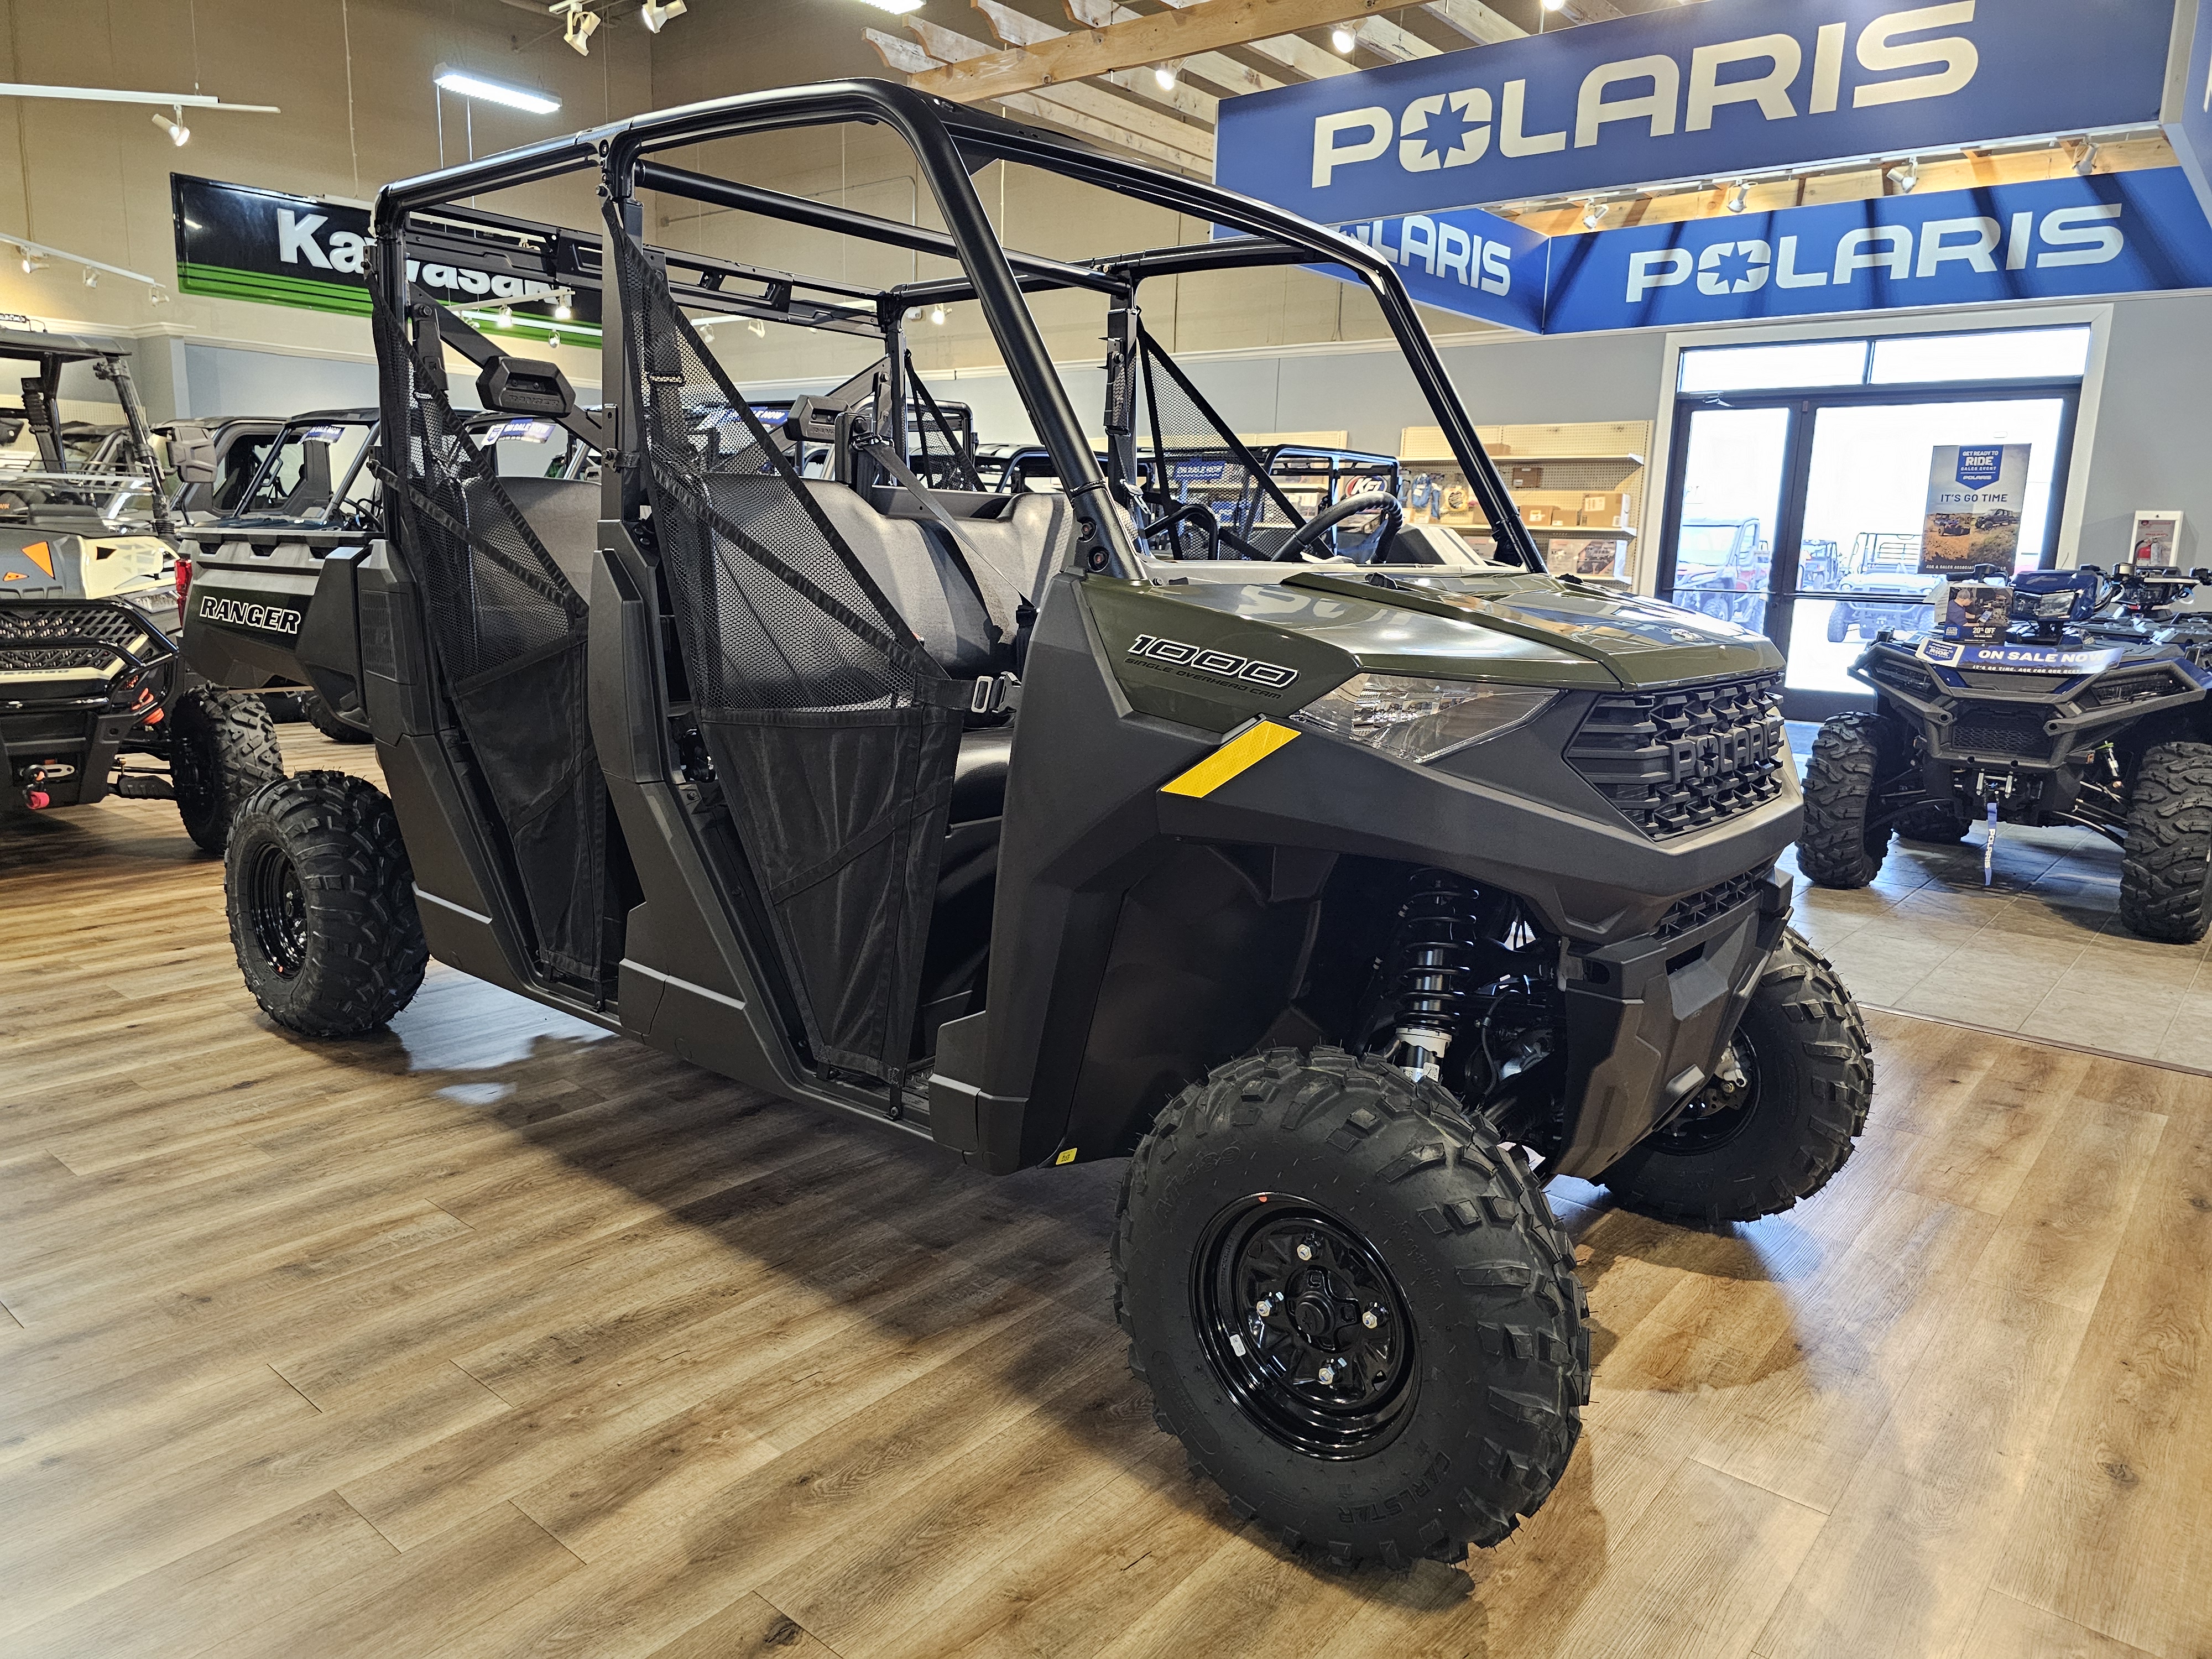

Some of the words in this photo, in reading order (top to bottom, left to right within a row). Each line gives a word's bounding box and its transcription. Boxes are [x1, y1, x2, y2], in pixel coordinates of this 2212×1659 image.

[1312, 0, 1979, 188] POLARIS
[1626, 203, 2124, 302] POLARIS
[1965, 456, 1994, 466] RIDE
[1940, 494, 1961, 502] IT'S
[1964, 494, 1978, 502] GO
[1982, 494, 2008, 502] TIME
[199, 596, 301, 635] RANGER
[1128, 634, 1299, 689] 1000
[1978, 650, 2005, 660] ON
[2007, 651, 2058, 662] SALE
[2061, 652, 2107, 663] NOW
[1125, 657, 1172, 674] SINGLE
[1176, 670, 1248, 692] OVERHEAD
[1249, 687, 1282, 700] CAM
[1673, 717, 1784, 784] POLARIS
[1984, 828, 1996, 869] POLARIS
[1335, 1449, 1453, 1525] CARLSTAR
